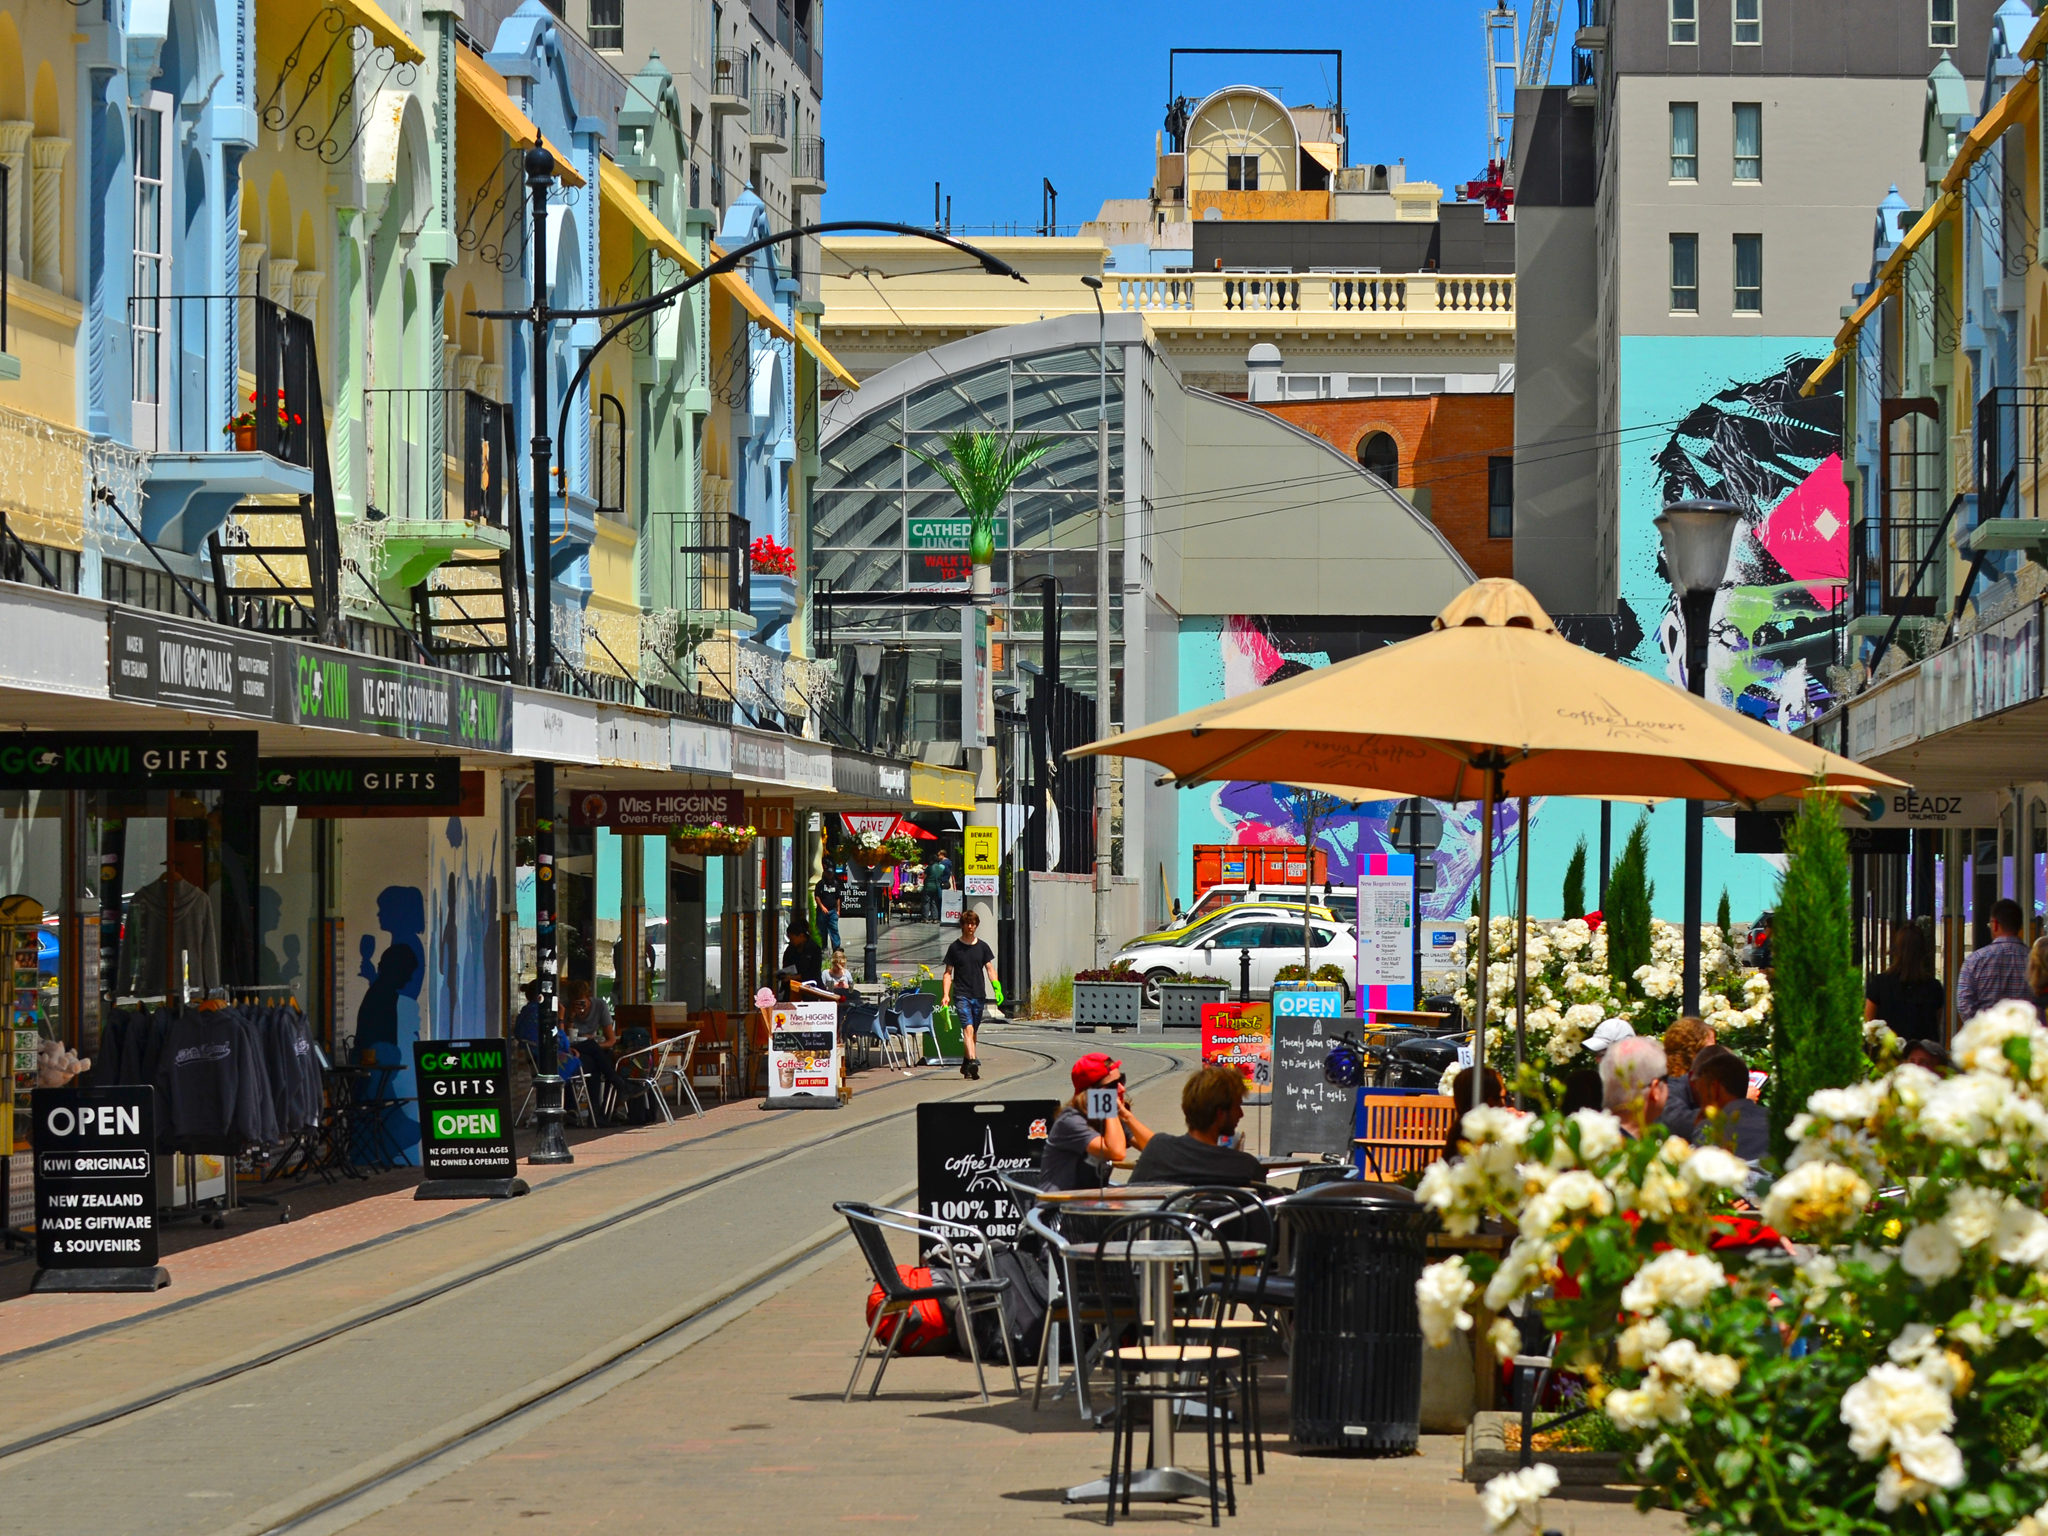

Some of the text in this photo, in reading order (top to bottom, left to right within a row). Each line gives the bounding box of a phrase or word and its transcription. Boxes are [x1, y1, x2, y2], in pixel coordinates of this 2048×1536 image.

[925, 555, 958, 567] WALK
[941, 568, 957, 580] TO
[160, 641, 232, 693] KIWI ORIGINALS
[300, 655, 349, 720] GO KIWI
[363, 678, 374, 714] NZ
[377, 679, 401, 718] GIFTS
[407, 685, 448, 726] SOUVENIRS
[459, 685, 475, 739] GO
[477, 690, 498, 741] KIWI
[1557, 708, 1686, 731] Coffee Lovers
[1, 746, 228, 774] GO KIWI GIFTS
[298, 769, 352, 792] KIWI
[363, 773, 435, 790] GIFTS
[656, 796, 727, 812] HIGGINS
[1893, 796, 1962, 813] BEADZ
[620, 813, 728, 824] Oven Fresh Cookies
[859, 820, 884, 832] GIVE
[841, 902, 862, 910] Spirits
[1279, 998, 1335, 1013] OPEN
[1209, 1011, 1263, 1030] Thirst
[1211, 1034, 1263, 1043] Smoothies
[1280, 1035, 1304, 1054] twenty
[1305, 1038, 1323, 1049] seven
[1233, 1045, 1241, 1054] &
[421, 1052, 502, 1071] GO KIWI
[776, 1056, 831, 1070] Coffee 2 Go!
[1217, 1053, 1257, 1064] Frappés
[1461, 1051, 1472, 1065] 15
[1256, 1062, 1269, 1081] 25
[433, 1080, 495, 1095] GIFTS
[1286, 1083, 1299, 1095] Now
[1315, 1083, 1324, 1102] 7
[1092, 1093, 1112, 1113] 18
[1310, 1102, 1323, 1114] 5pm
[47, 1106, 140, 1136] OPEN
[438, 1114, 496, 1135] OPEN
[43, 1157, 146, 1171] KIWI ORIGINALS
[944, 1154, 1031, 1178] Coffee Lovers
[48, 1194, 143, 1207] NEW ZEALAND
[930, 1199, 1020, 1220] 100% FA
[41, 1216, 152, 1230] MADE GIFTWARE
[930, 1225, 979, 1238] TRADE
[53, 1239, 141, 1252] & SOUVENIRS
